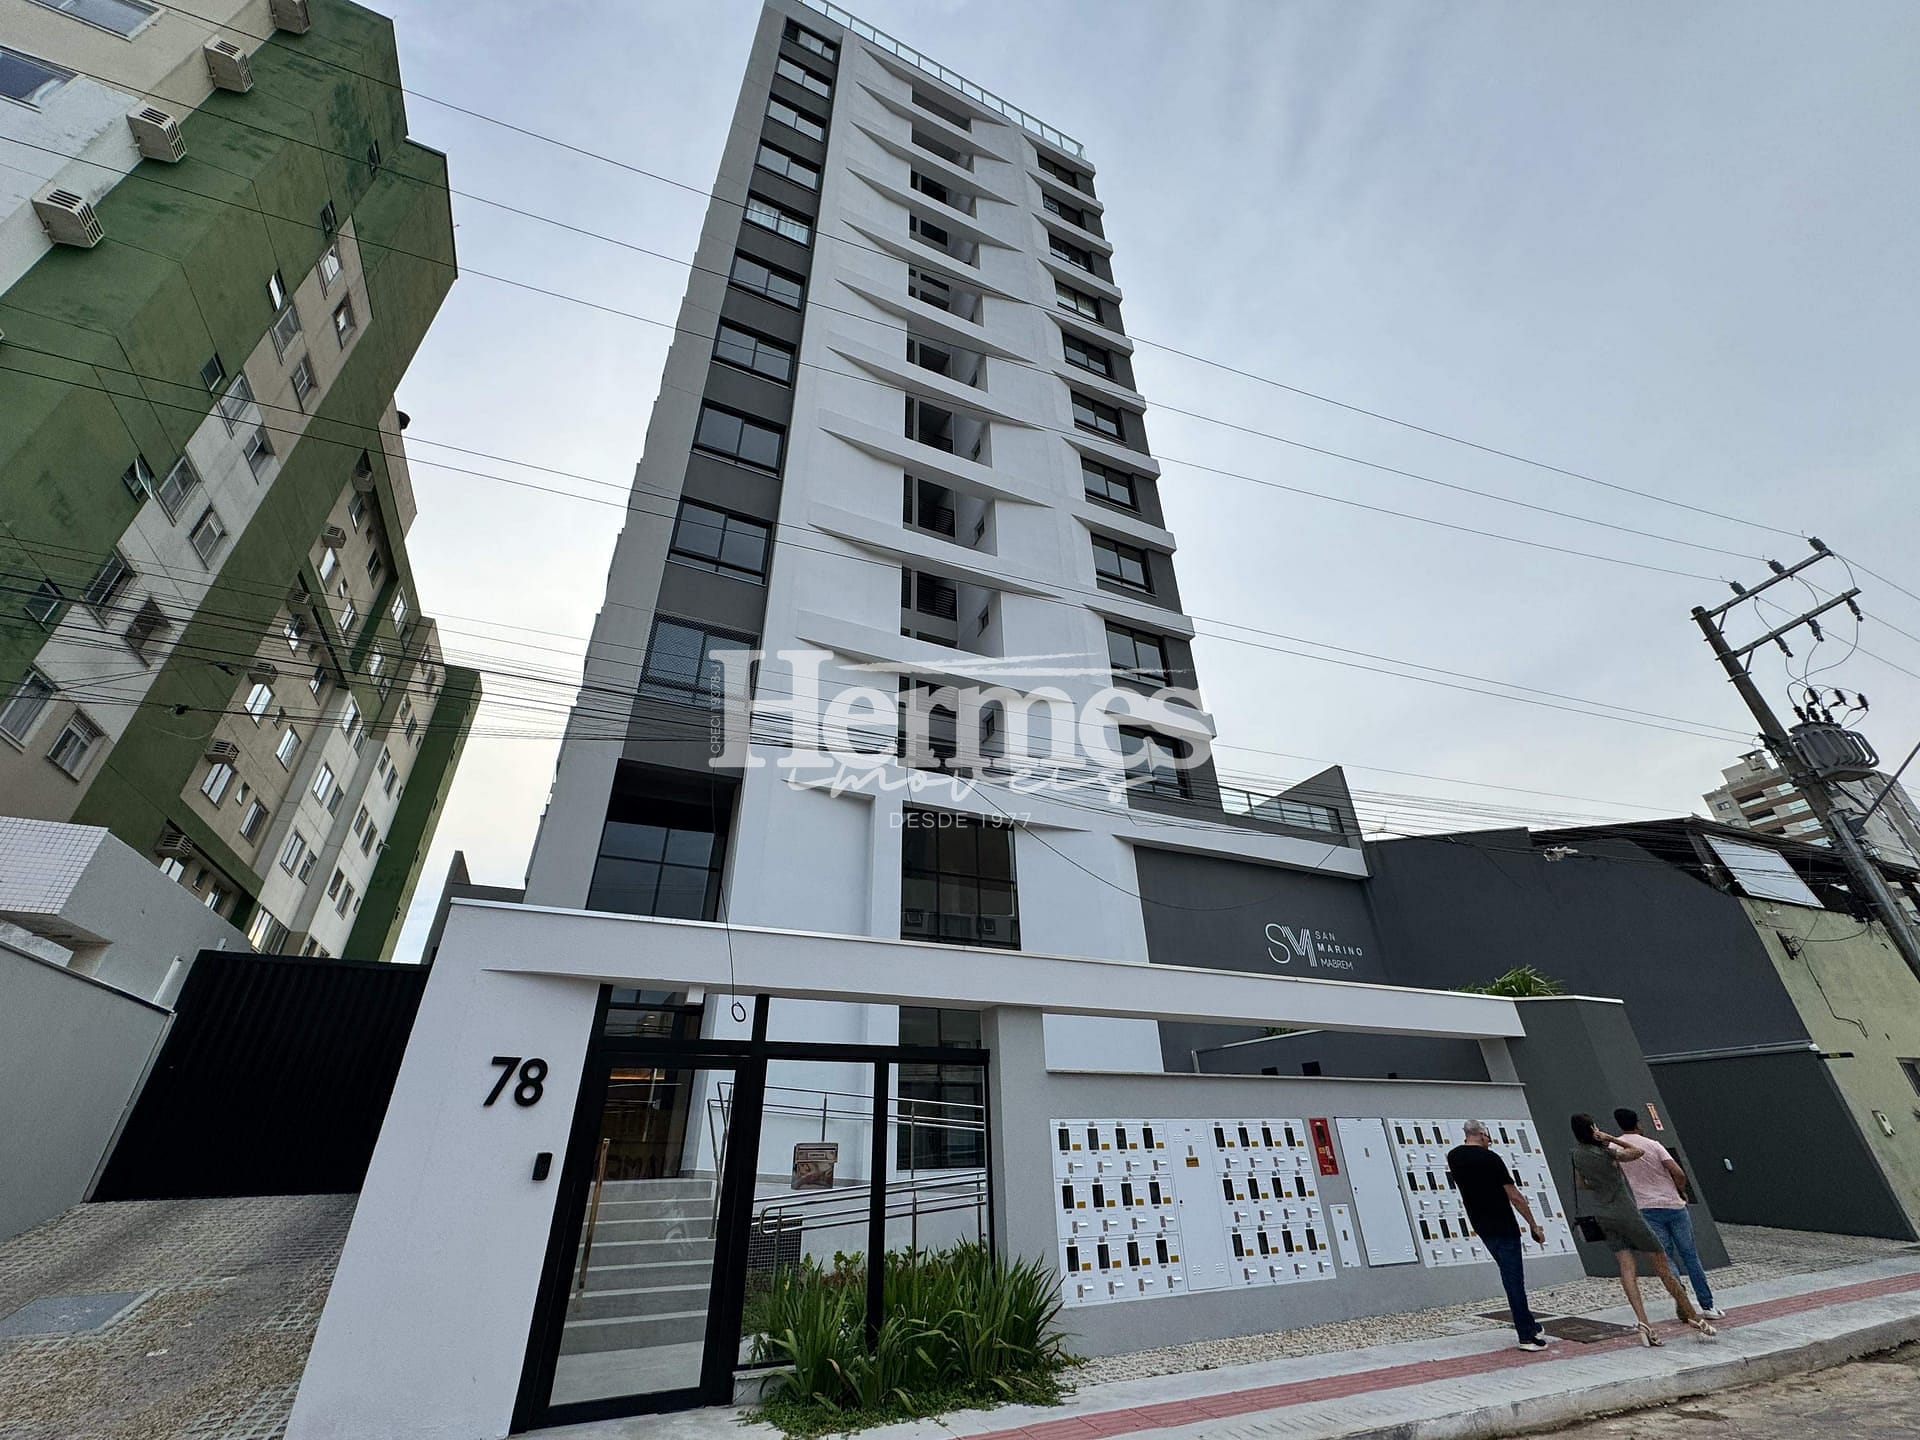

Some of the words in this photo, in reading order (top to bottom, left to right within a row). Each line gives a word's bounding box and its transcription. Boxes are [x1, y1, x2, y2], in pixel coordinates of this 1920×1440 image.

[1314, 930, 1337, 941] SAN
[1316, 942, 1363, 957] MARINO
[483, 1056, 549, 1107] 78
